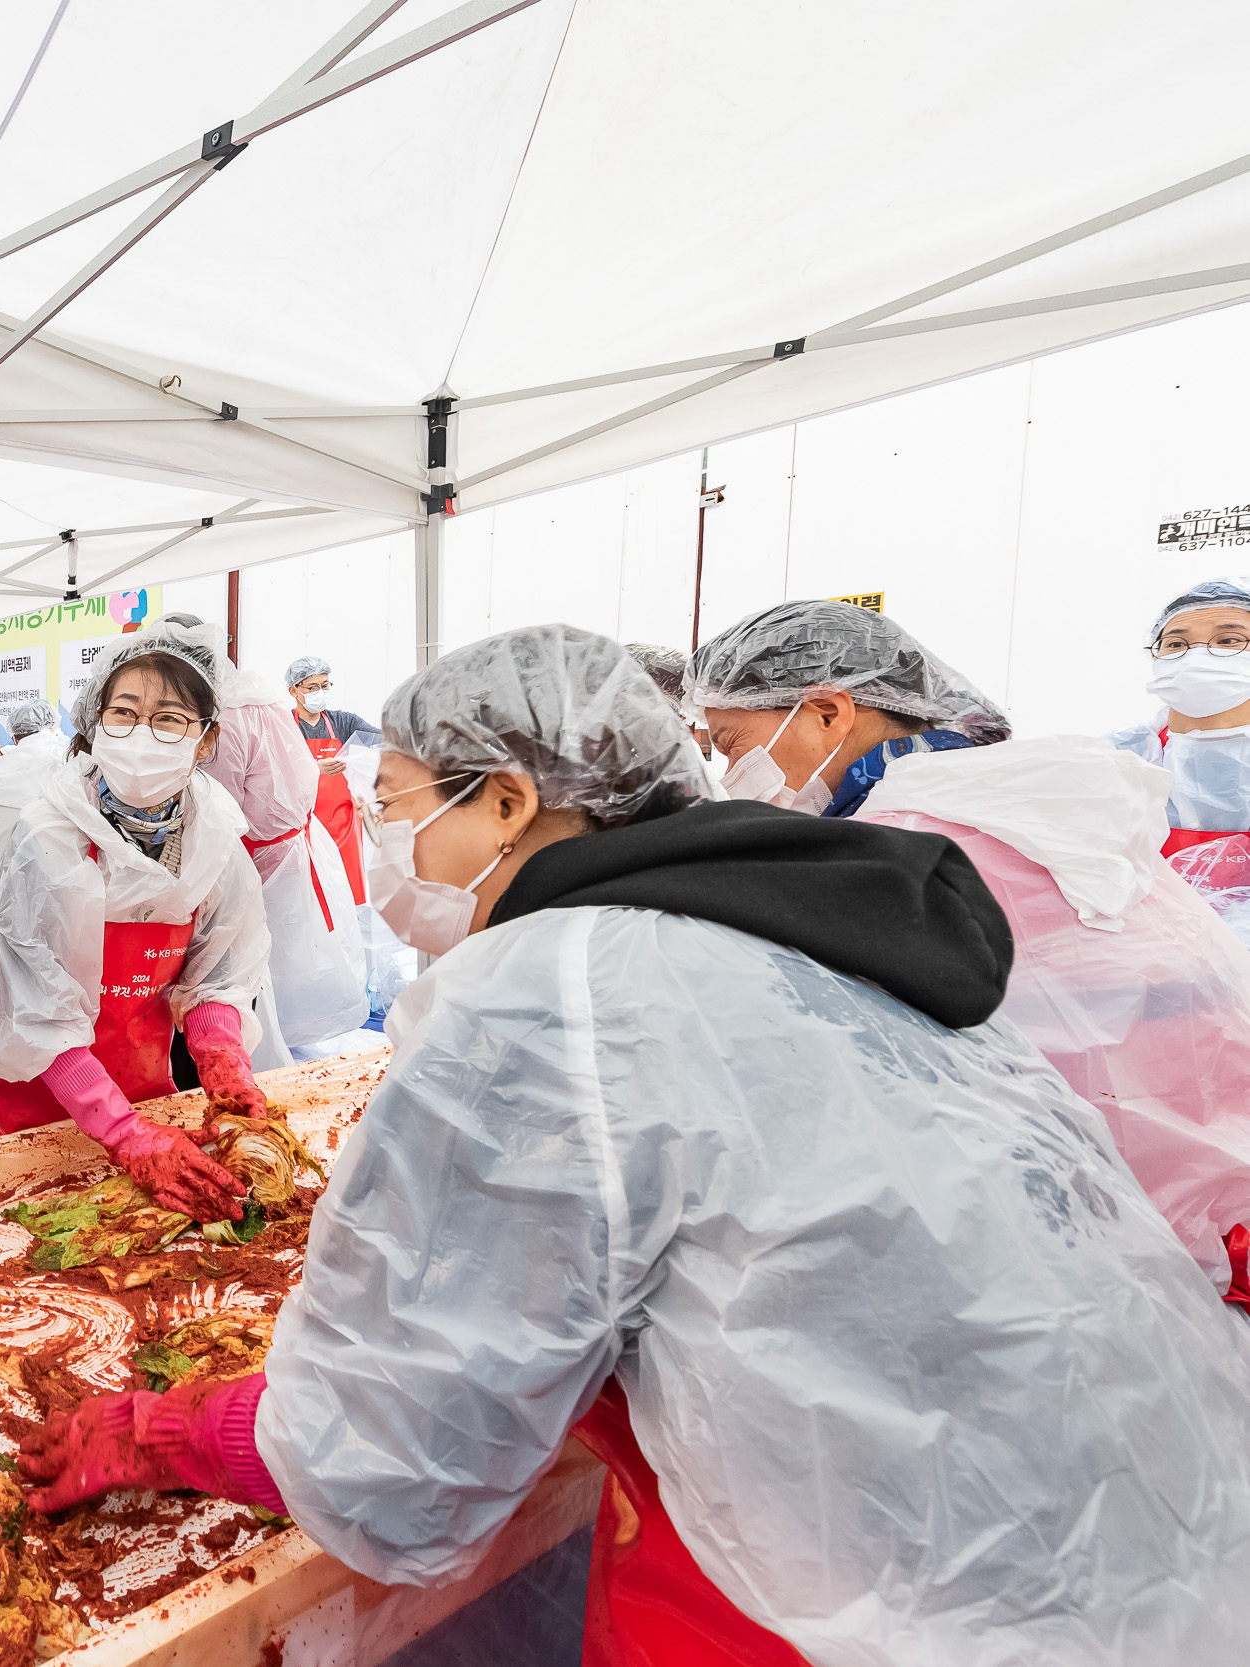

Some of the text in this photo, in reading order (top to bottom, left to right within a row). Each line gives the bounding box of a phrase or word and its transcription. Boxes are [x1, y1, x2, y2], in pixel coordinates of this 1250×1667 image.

[81, 646, 105, 665] 답례
[0, 656, 31, 674] 세액공제
[158, 949, 171, 958] KB
[132, 974, 150, 983] 2024
[111, 985, 130, 998] 광진
